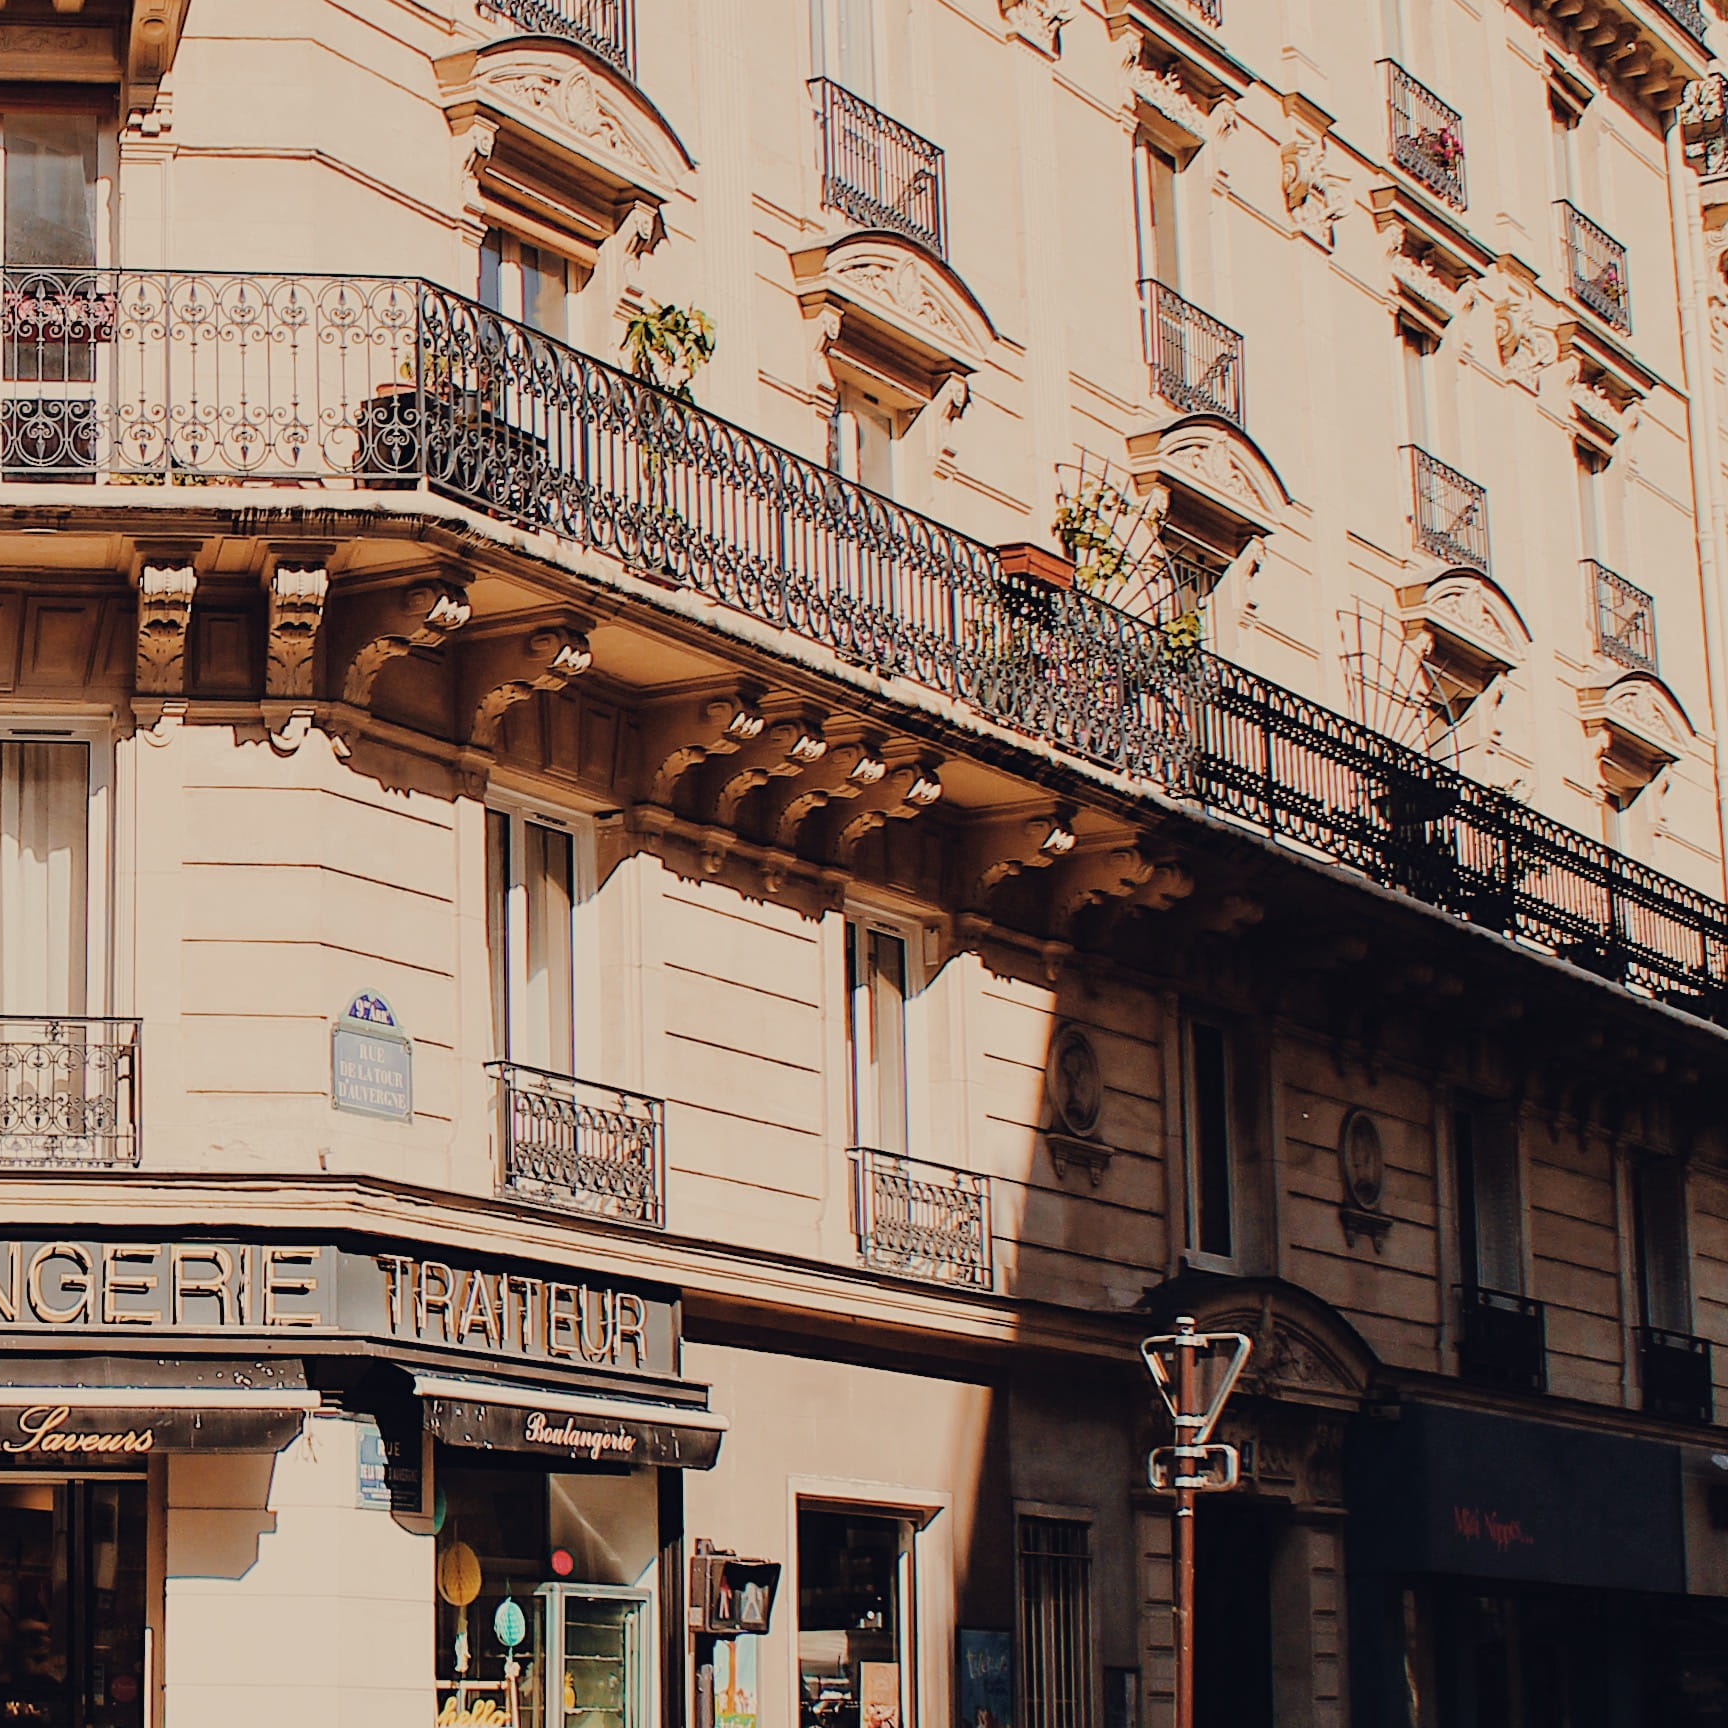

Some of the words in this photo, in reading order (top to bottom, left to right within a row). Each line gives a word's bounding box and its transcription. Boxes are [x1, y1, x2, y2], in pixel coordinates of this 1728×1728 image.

[359, 1043, 385, 1064] RUE
[339, 1060, 356, 1078] DE
[357, 1063, 373, 1082] LA
[373, 1067, 404, 1089] TOUR
[337, 1078, 406, 1109] D'AUVERGNE
[378, 1253, 648, 1366] TRAITEUR
[3, 1404, 156, 1454] Saveurs
[524, 1411, 637, 1460] Boulangerie
[437, 1695, 511, 1728] hello
